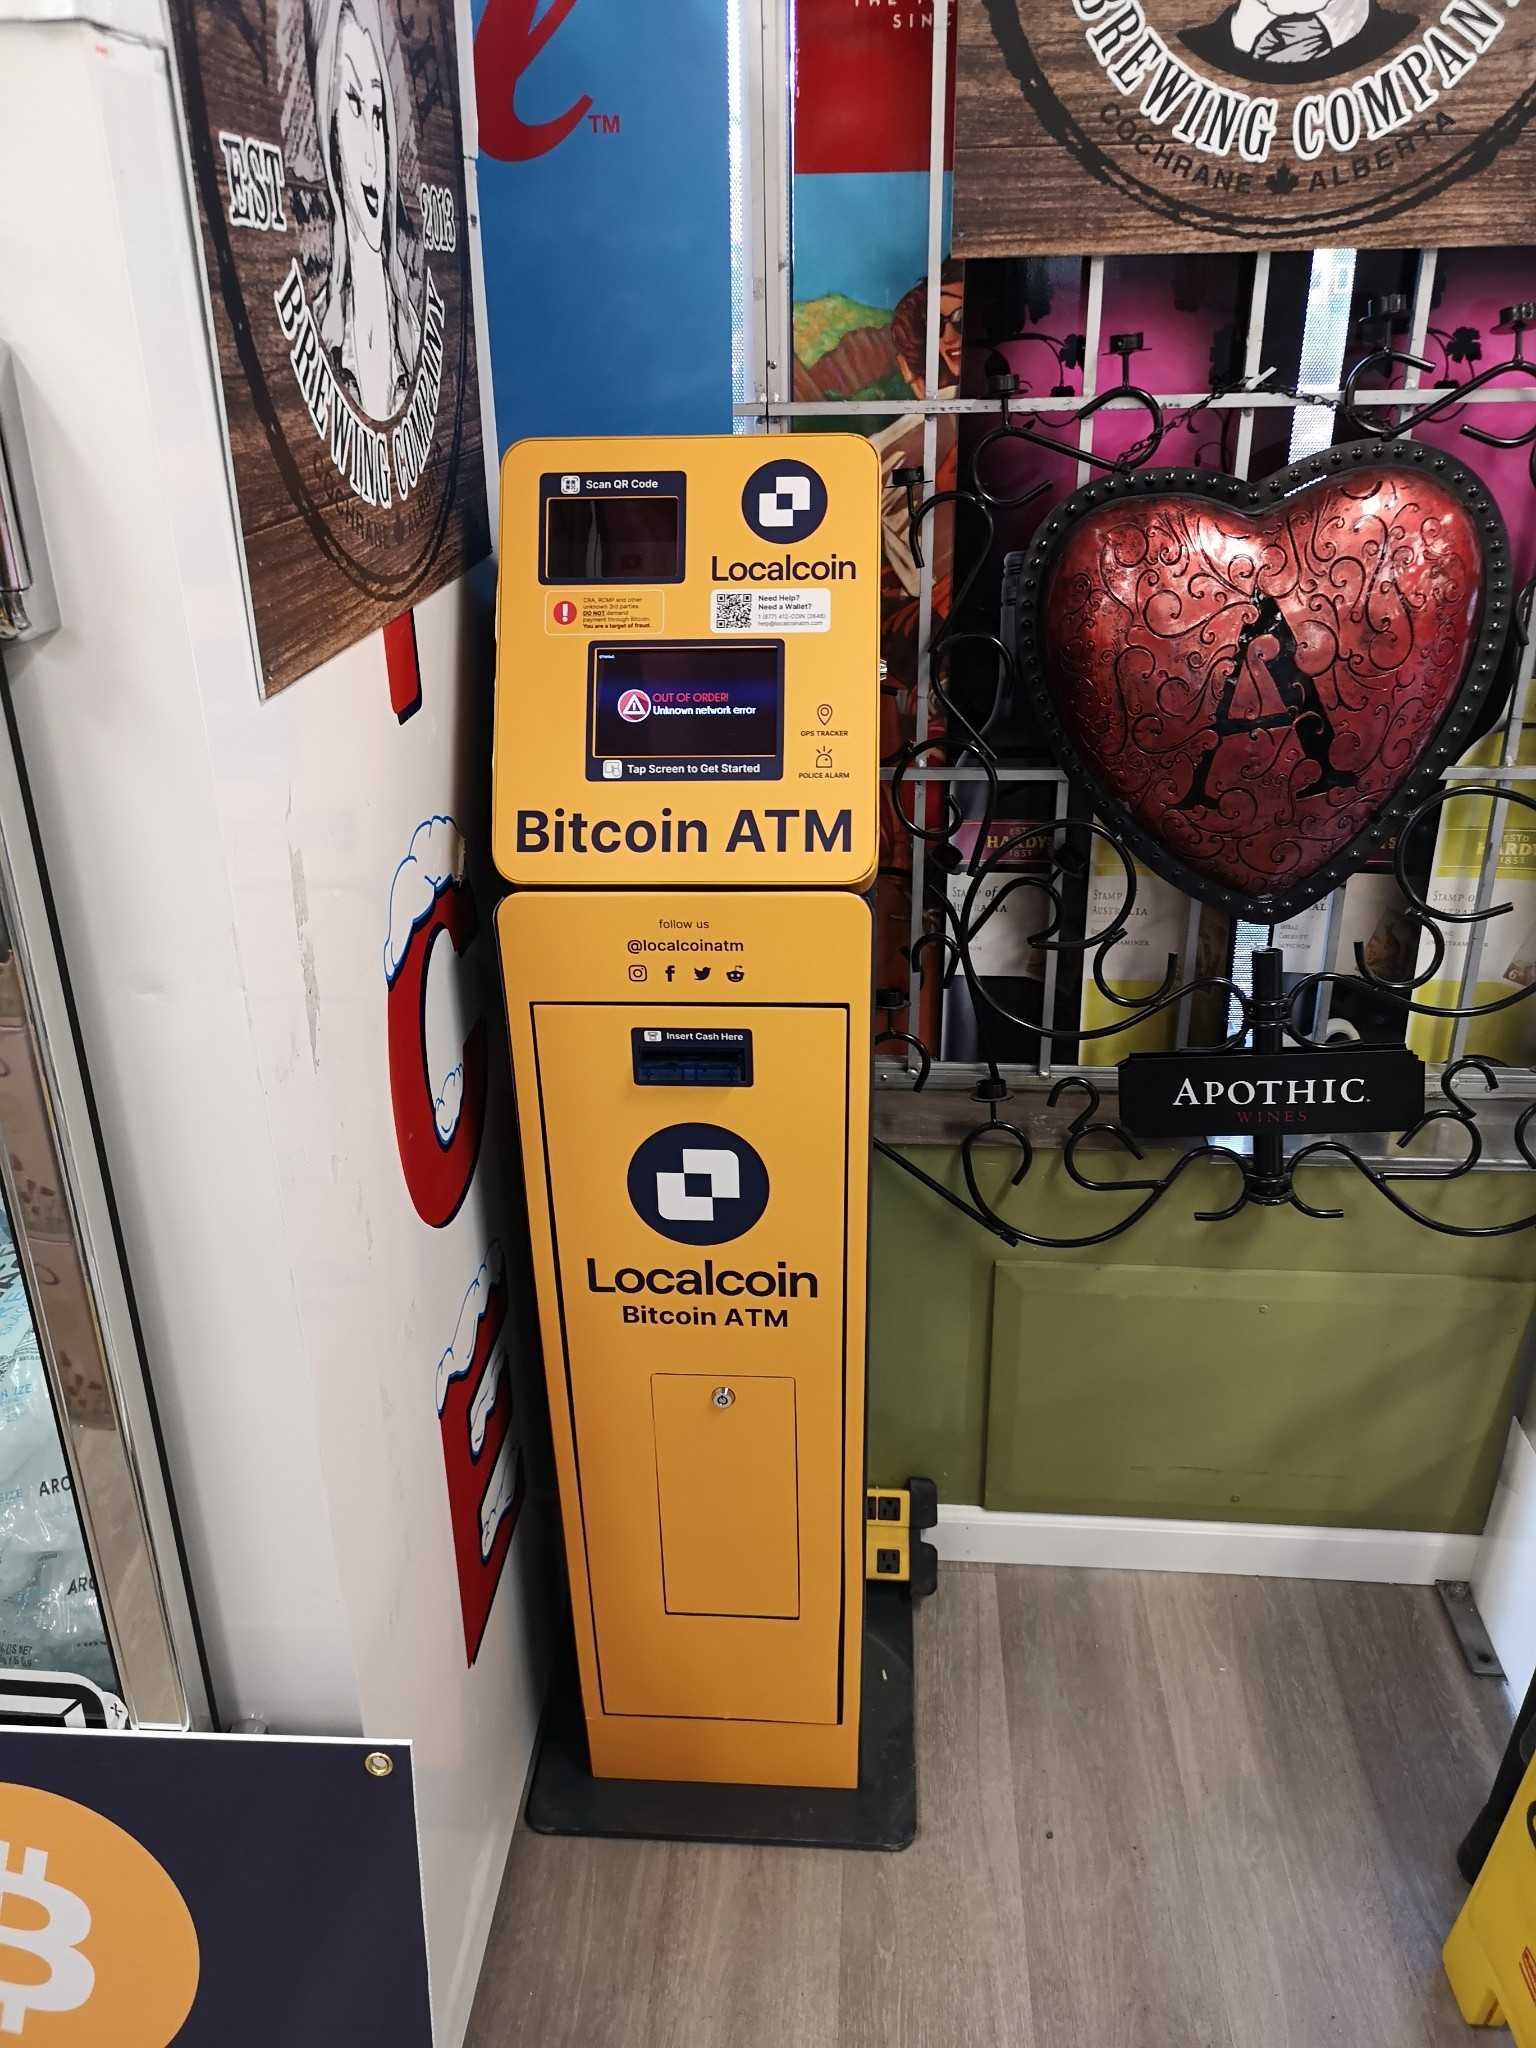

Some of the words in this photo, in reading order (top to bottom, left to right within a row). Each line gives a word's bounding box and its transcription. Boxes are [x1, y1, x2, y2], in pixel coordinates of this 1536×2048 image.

[588, 114, 621, 134] TM
[1101, 102, 1253, 194] COCHRANE
[1308, 111, 1456, 193] ALBERTA
[218, 130, 287, 232] EST
[273, 257, 391, 509] BREWING
[393, 266, 446, 500] COMPANY
[585, 479, 612, 490] Scan
[613, 479, 629, 490] QR
[631, 479, 659, 489] Code
[711, 553, 857, 582] Localcoin
[779, 594, 800, 602] Help?
[652, 693, 674, 703] OUT
[677, 693, 691, 703] OF
[652, 705, 694, 716] Unknown
[695, 706, 731, 715] network
[733, 706, 757, 715] error
[627, 764, 646, 775] Tap
[648, 764, 685, 774] Screen
[687, 764, 698, 774] to
[700, 764, 718, 774] Get
[721, 763, 760, 774] Started
[516, 807, 708, 854] Bitcoin
[725, 809, 853, 853] ATM
[658, 918, 692, 930] follow
[696, 921, 710, 930] us
[627, 939, 744, 954] @localcoinatm
[666, 1031, 693, 1042] Insert
[695, 1032, 719, 1042] Cash
[721, 1032, 744, 1042] Here
[1236, 1110, 1308, 1123] WINES
[587, 1257, 819, 1299] Localcoin
[622, 1305, 717, 1327] Bitcoin
[724, 1308, 789, 1328] ATM
